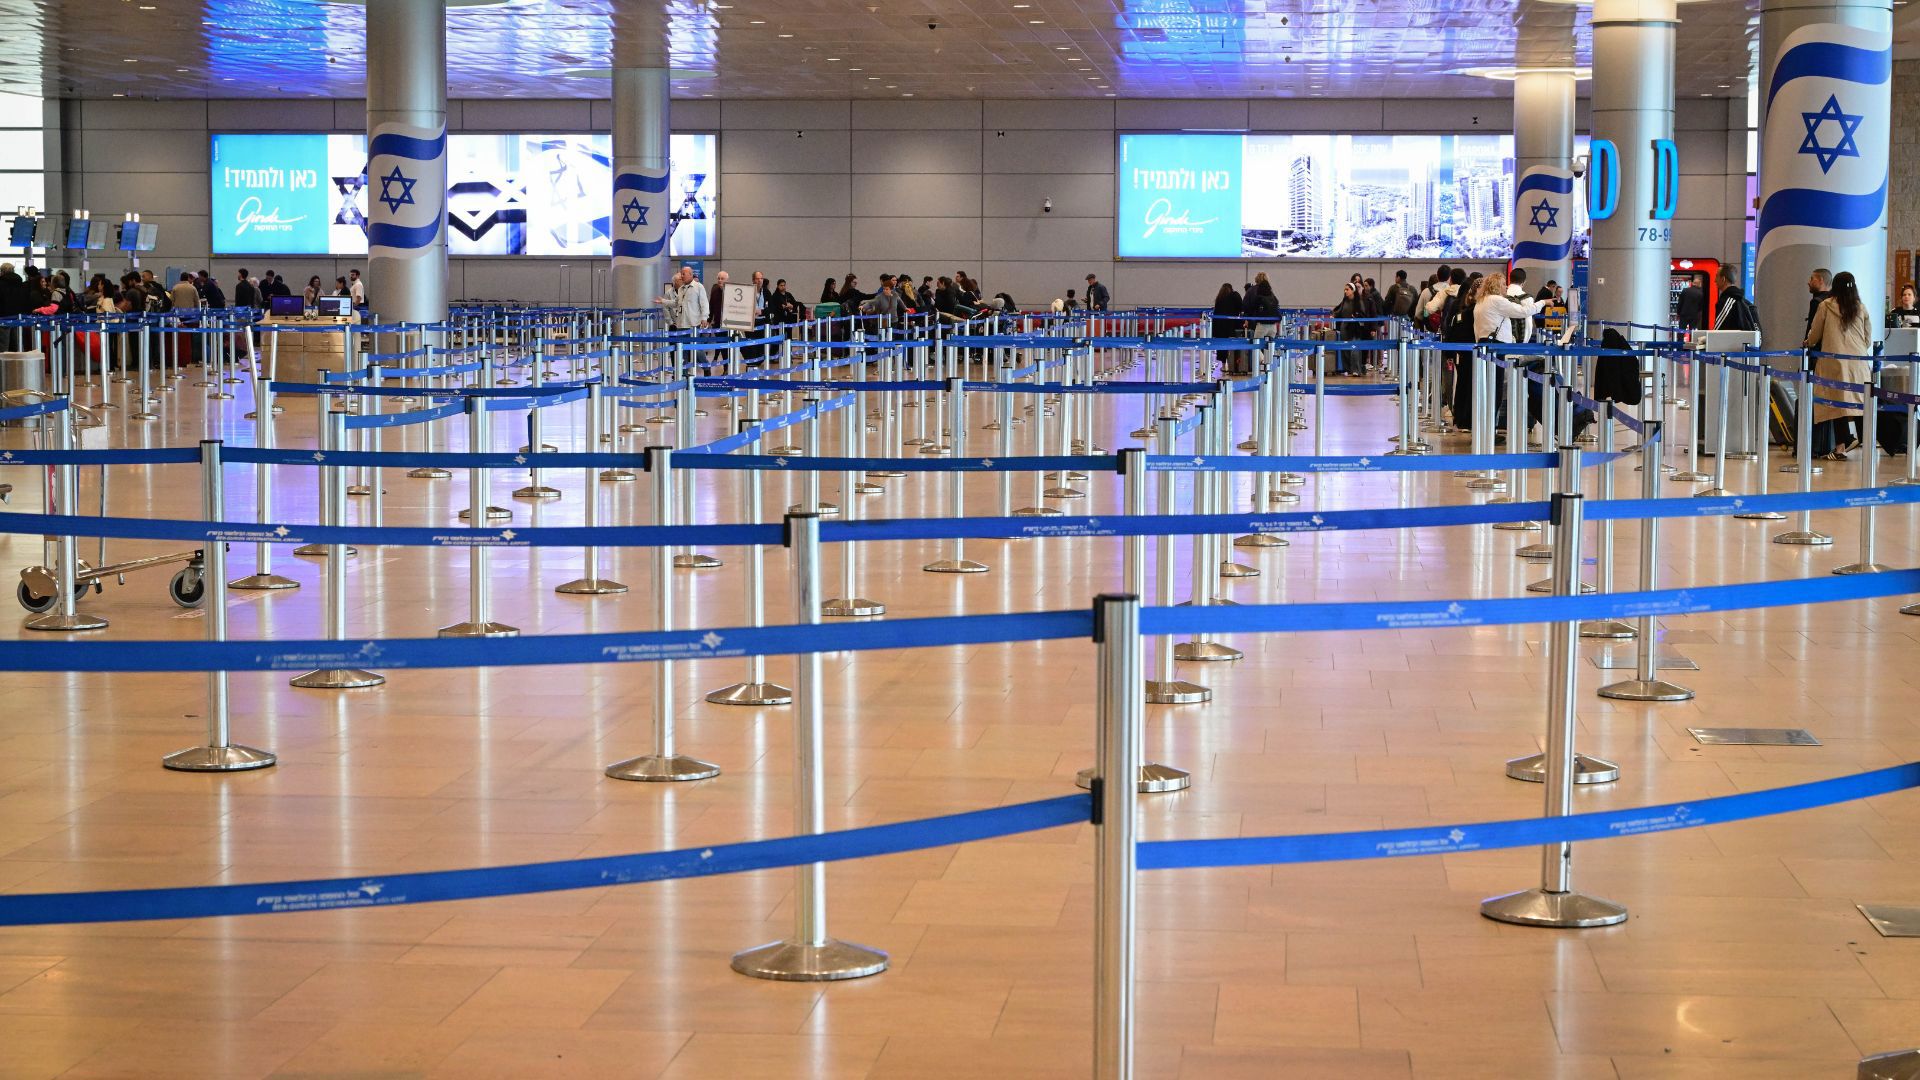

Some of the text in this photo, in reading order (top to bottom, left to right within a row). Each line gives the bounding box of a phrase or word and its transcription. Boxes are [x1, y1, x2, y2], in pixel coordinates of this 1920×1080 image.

[225, 166, 317, 191] כאן ולתמיד!
[1133, 168, 1230, 193] כאן ולתמיד!
[1587, 139, 1621, 220] D
[1649, 139, 1679, 220] D
[733, 287, 743, 302] 3
